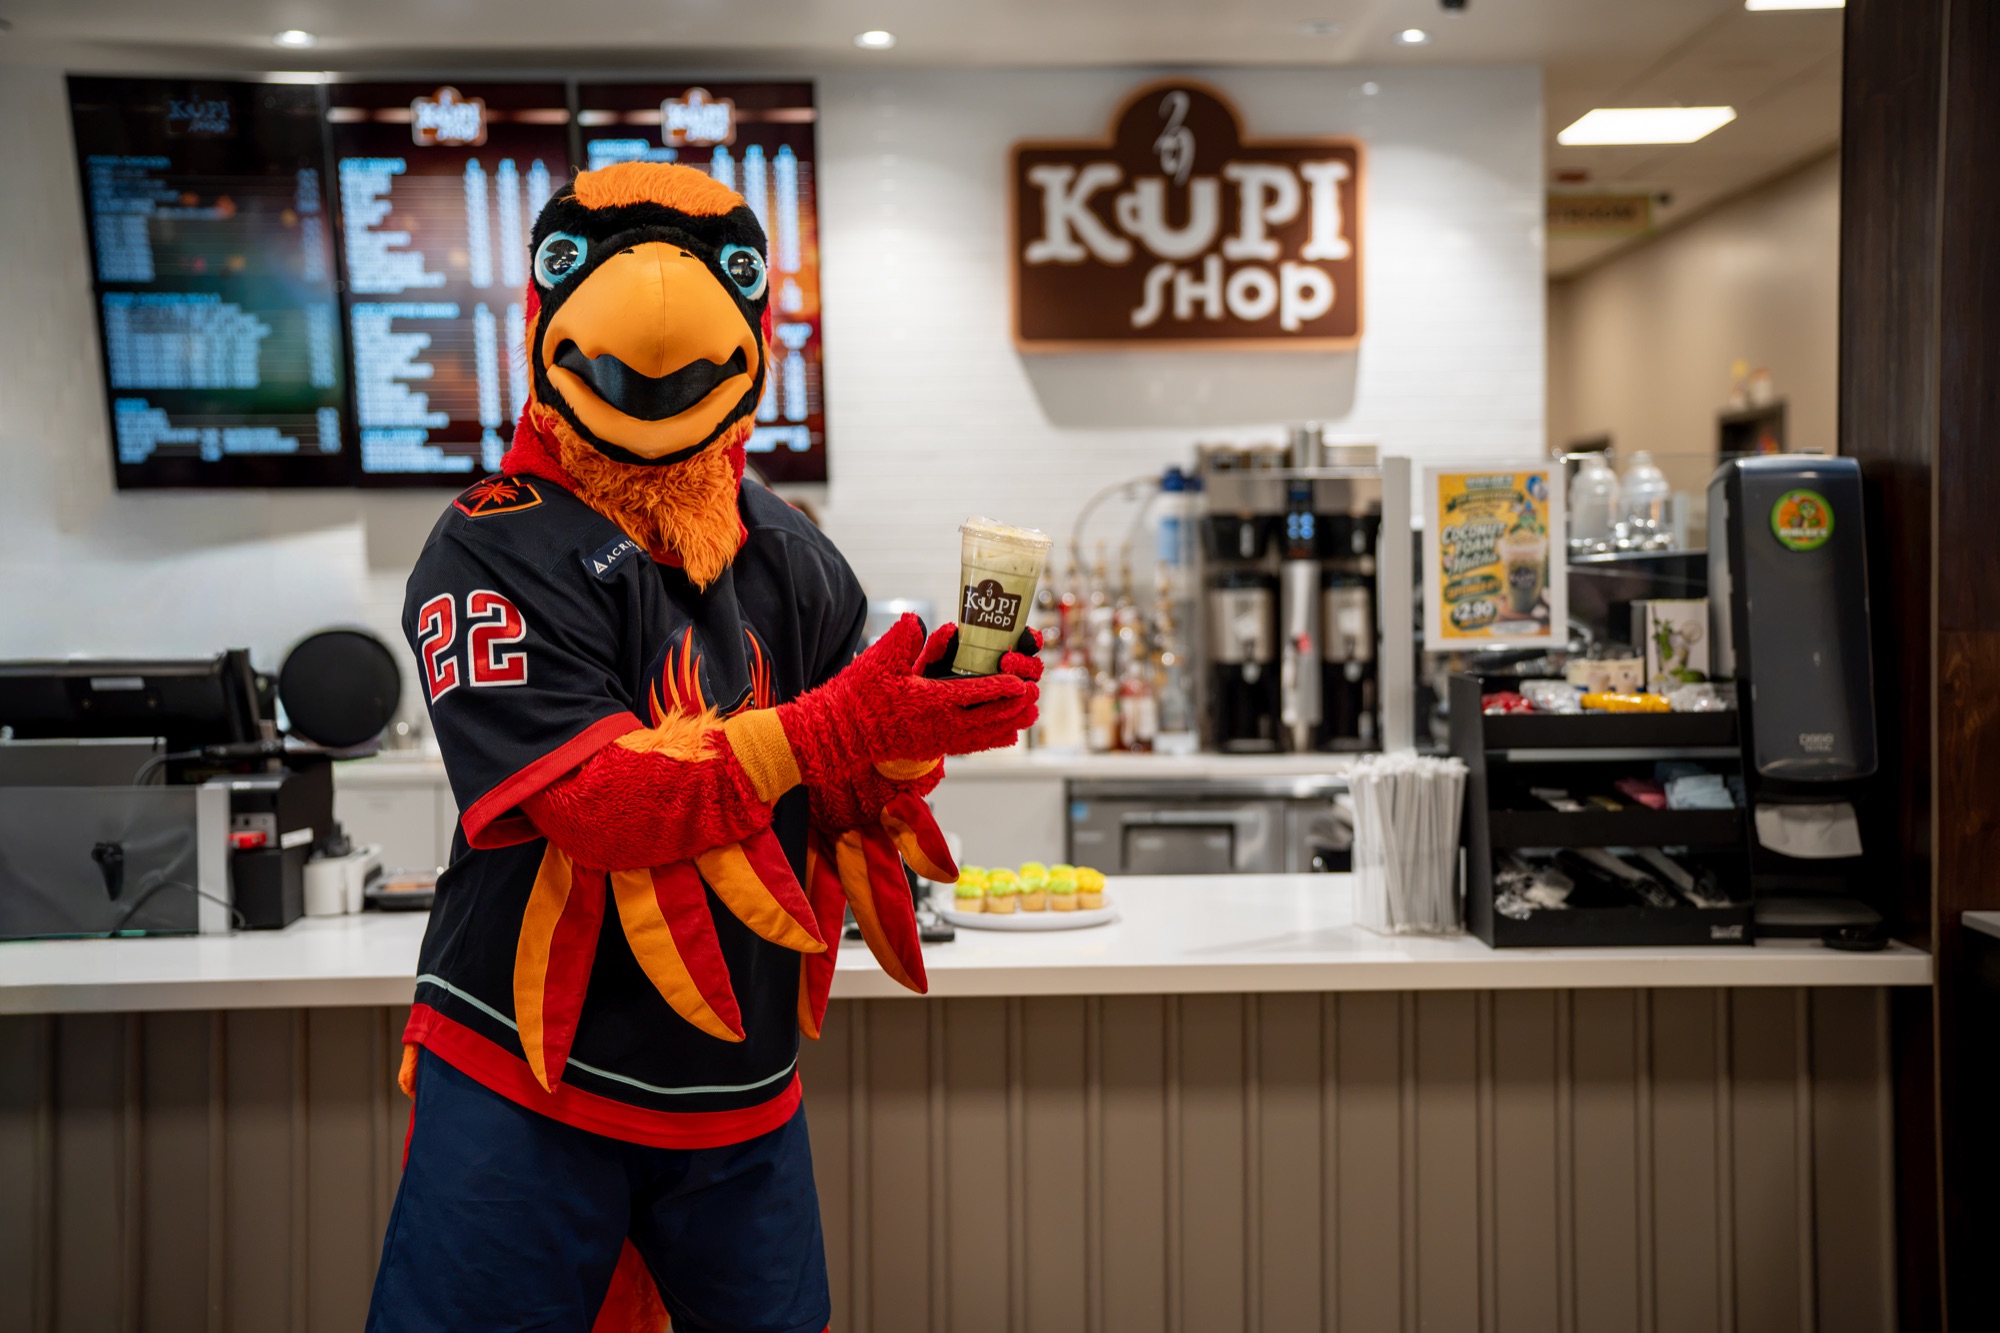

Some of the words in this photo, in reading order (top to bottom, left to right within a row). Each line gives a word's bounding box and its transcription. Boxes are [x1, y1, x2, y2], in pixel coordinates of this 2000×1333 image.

[1025, 161, 1349, 262] KUPI
[1131, 256, 1334, 331] SHOP
[964, 590, 1018, 616] KUPI
[977, 611, 1011, 627] SHOP
[419, 589, 528, 705] 22
